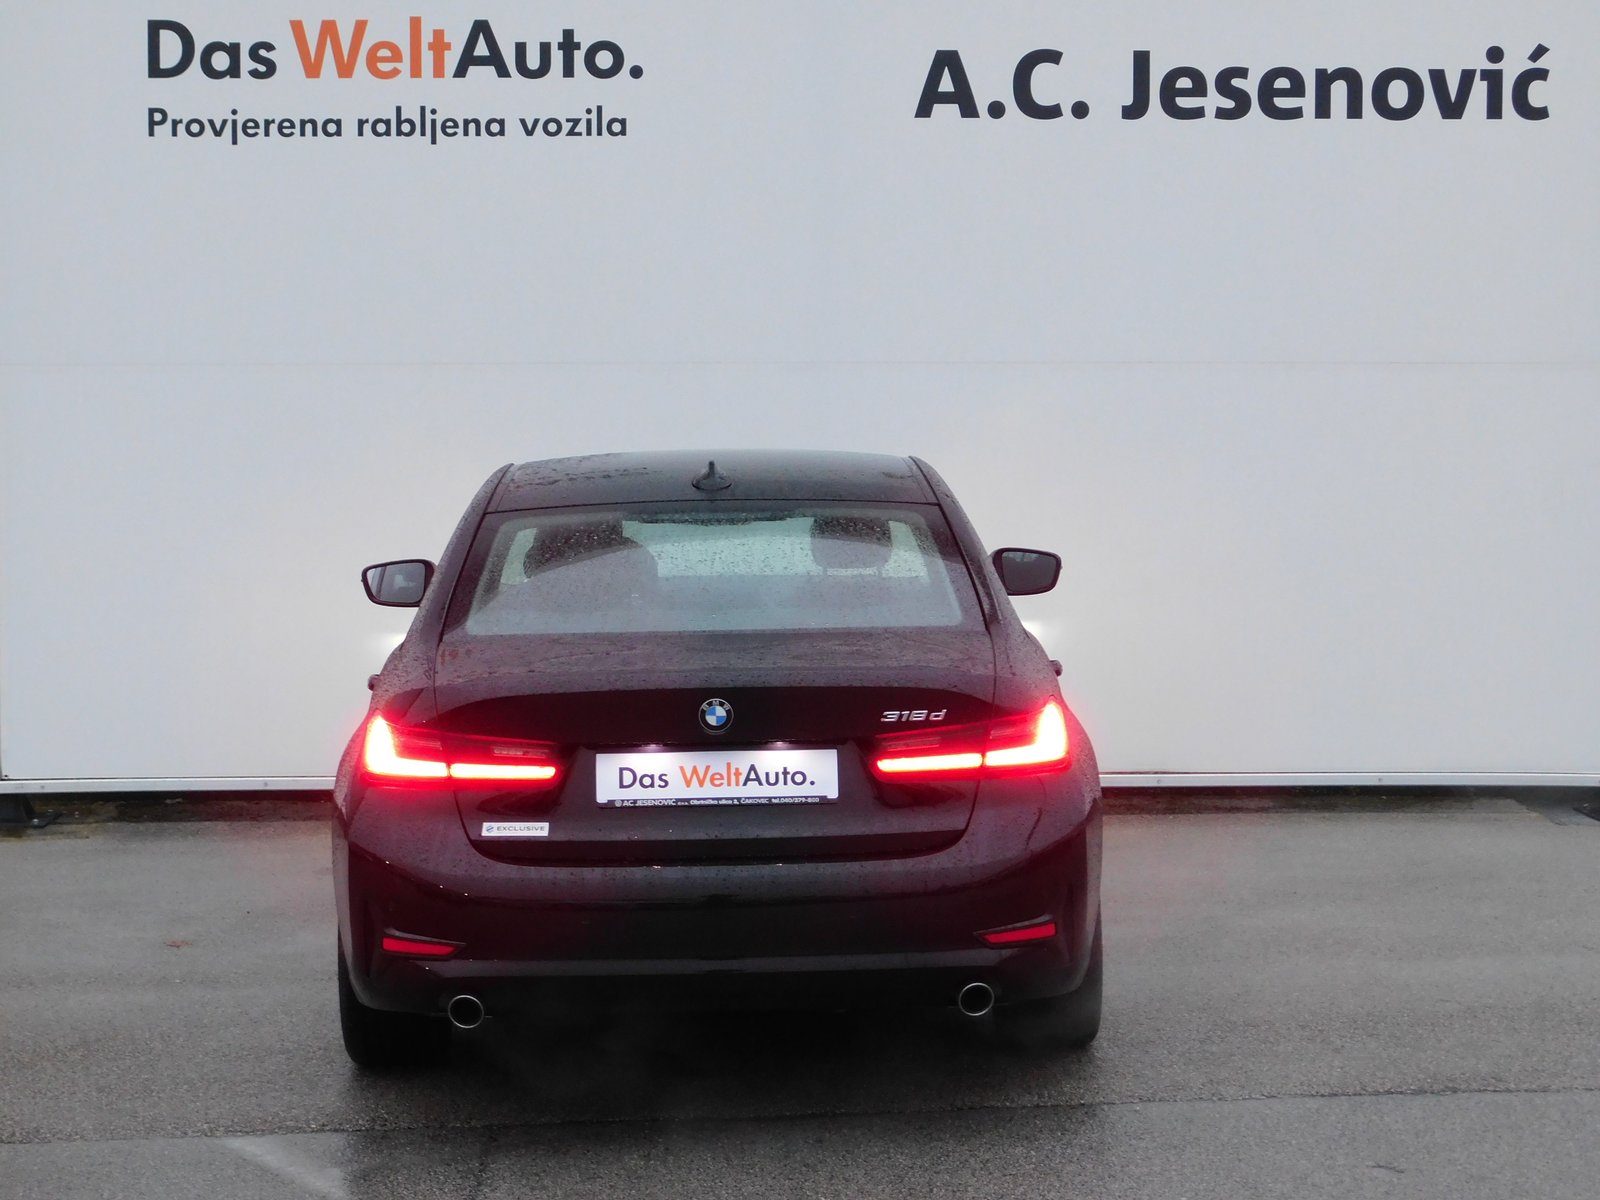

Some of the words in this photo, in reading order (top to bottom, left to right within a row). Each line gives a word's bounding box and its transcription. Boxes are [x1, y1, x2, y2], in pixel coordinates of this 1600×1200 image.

[147, 19, 278, 80] Das
[289, 16, 644, 80] WeltAuto.
[913, 48, 1090, 121] A.C.
[1121, 42, 1551, 122] Jesenović
[147, 107, 343, 146] Provjerena
[357, 105, 505, 146] rabljena
[519, 104, 627, 138] vozila
[618, 766, 669, 789] Das
